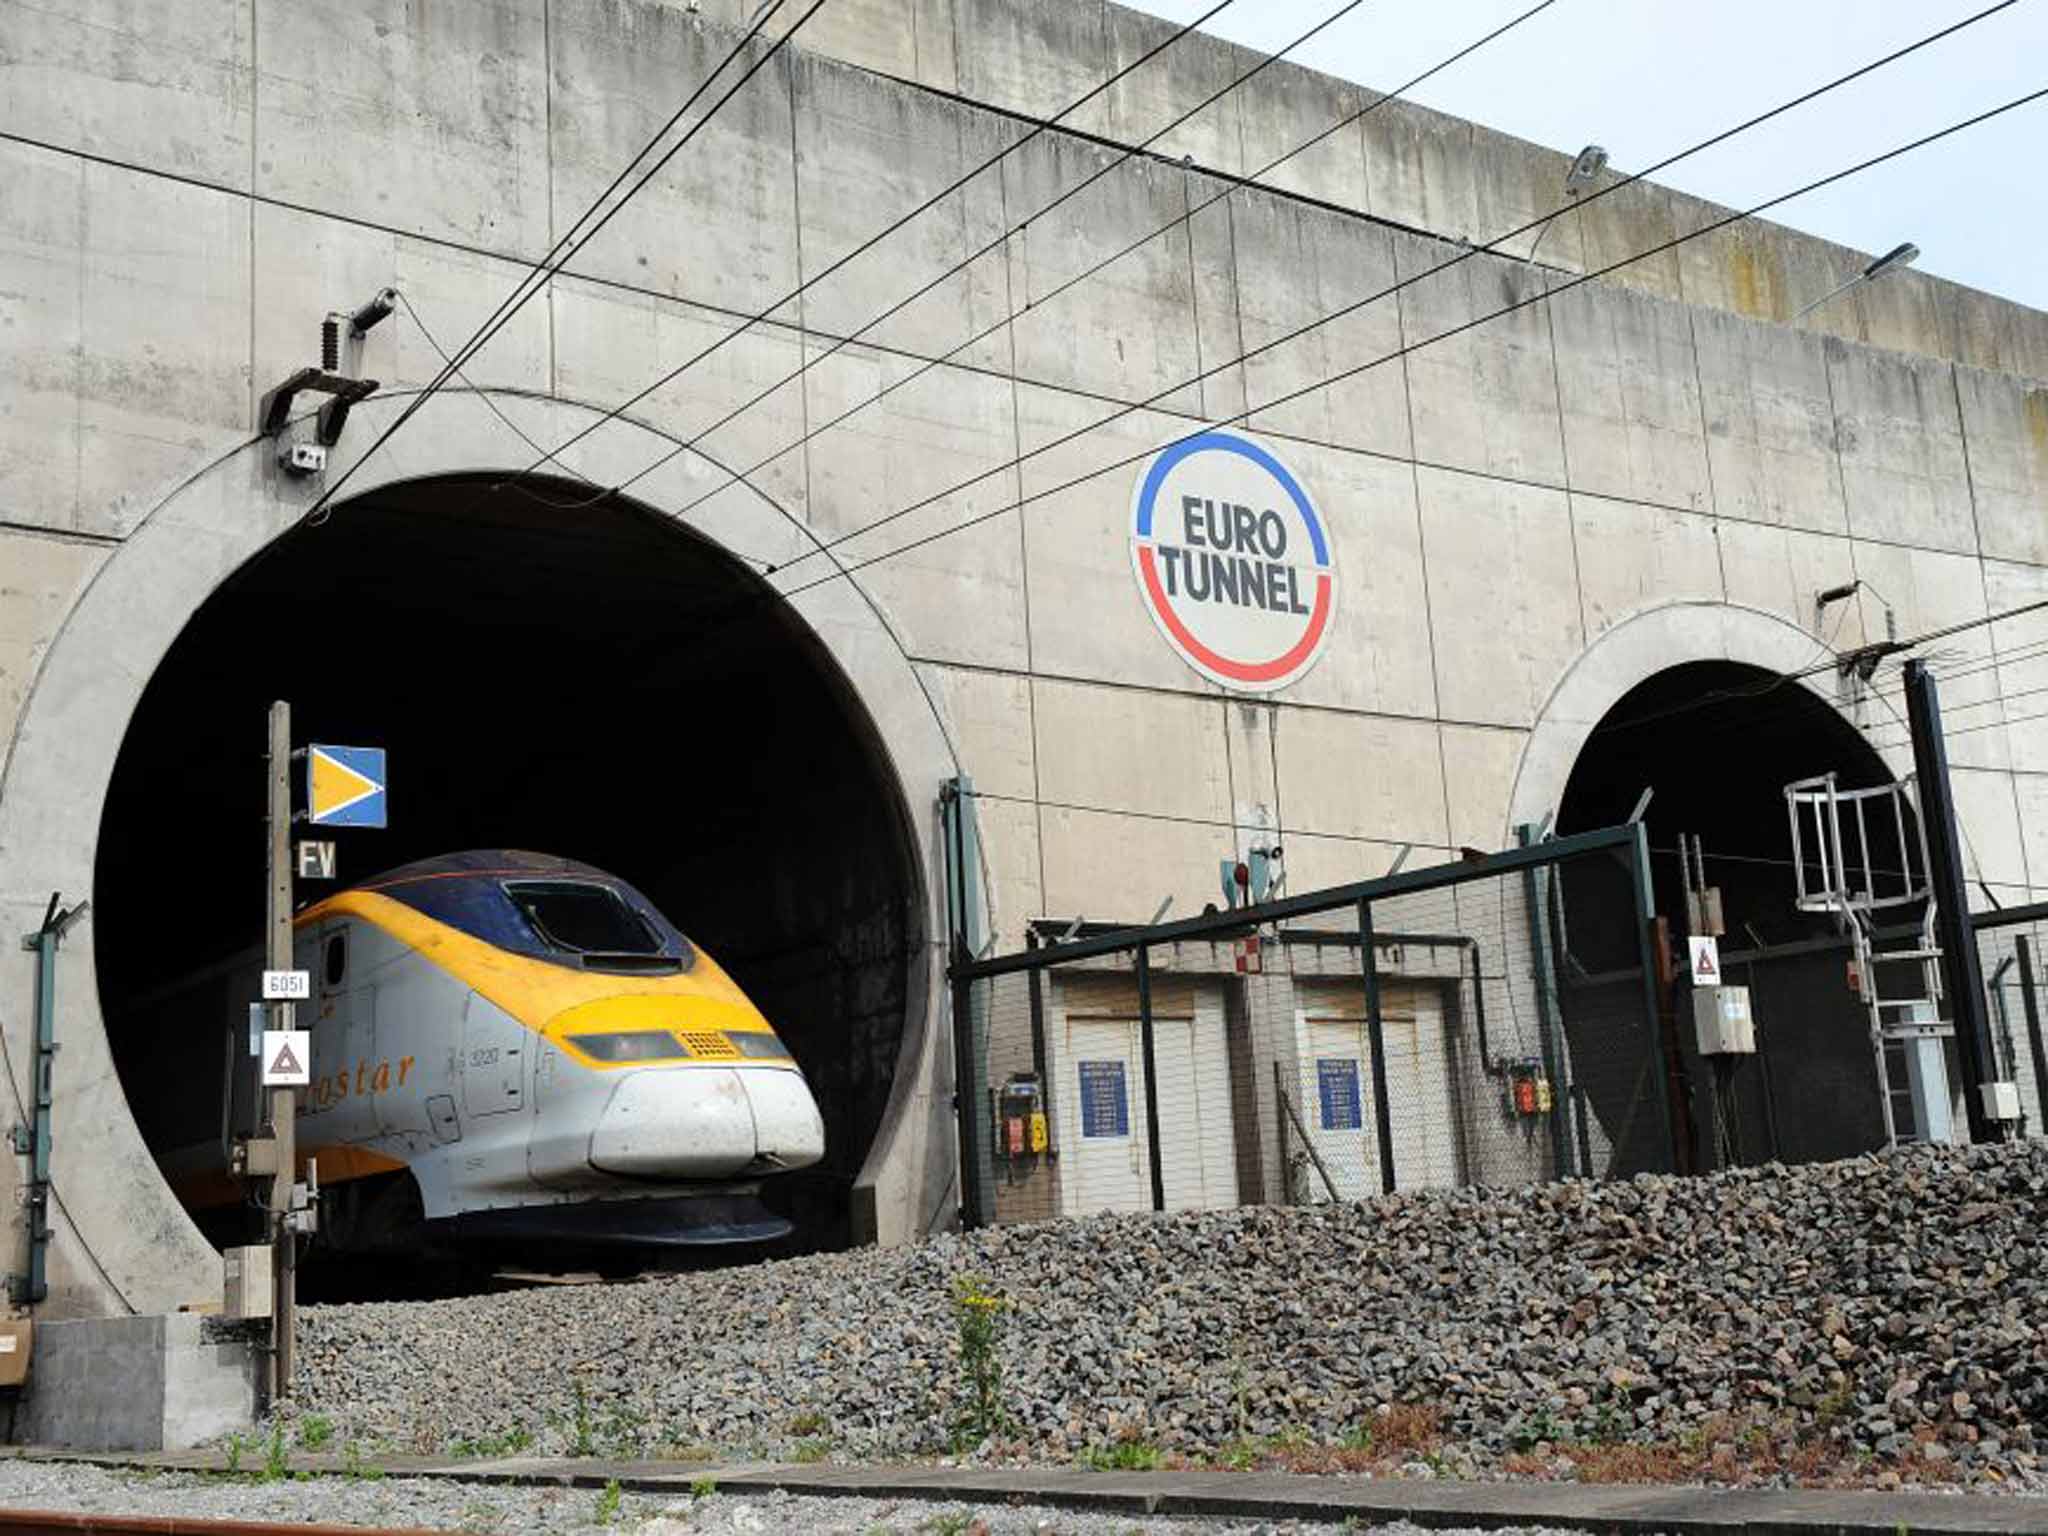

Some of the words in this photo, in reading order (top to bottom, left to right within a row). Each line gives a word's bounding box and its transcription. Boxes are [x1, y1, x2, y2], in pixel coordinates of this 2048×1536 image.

[1182, 496, 1287, 559] EURO
[1158, 545, 1309, 615] TUNNEL
[300, 841, 336, 878] FV
[271, 975, 303, 992] 6051
